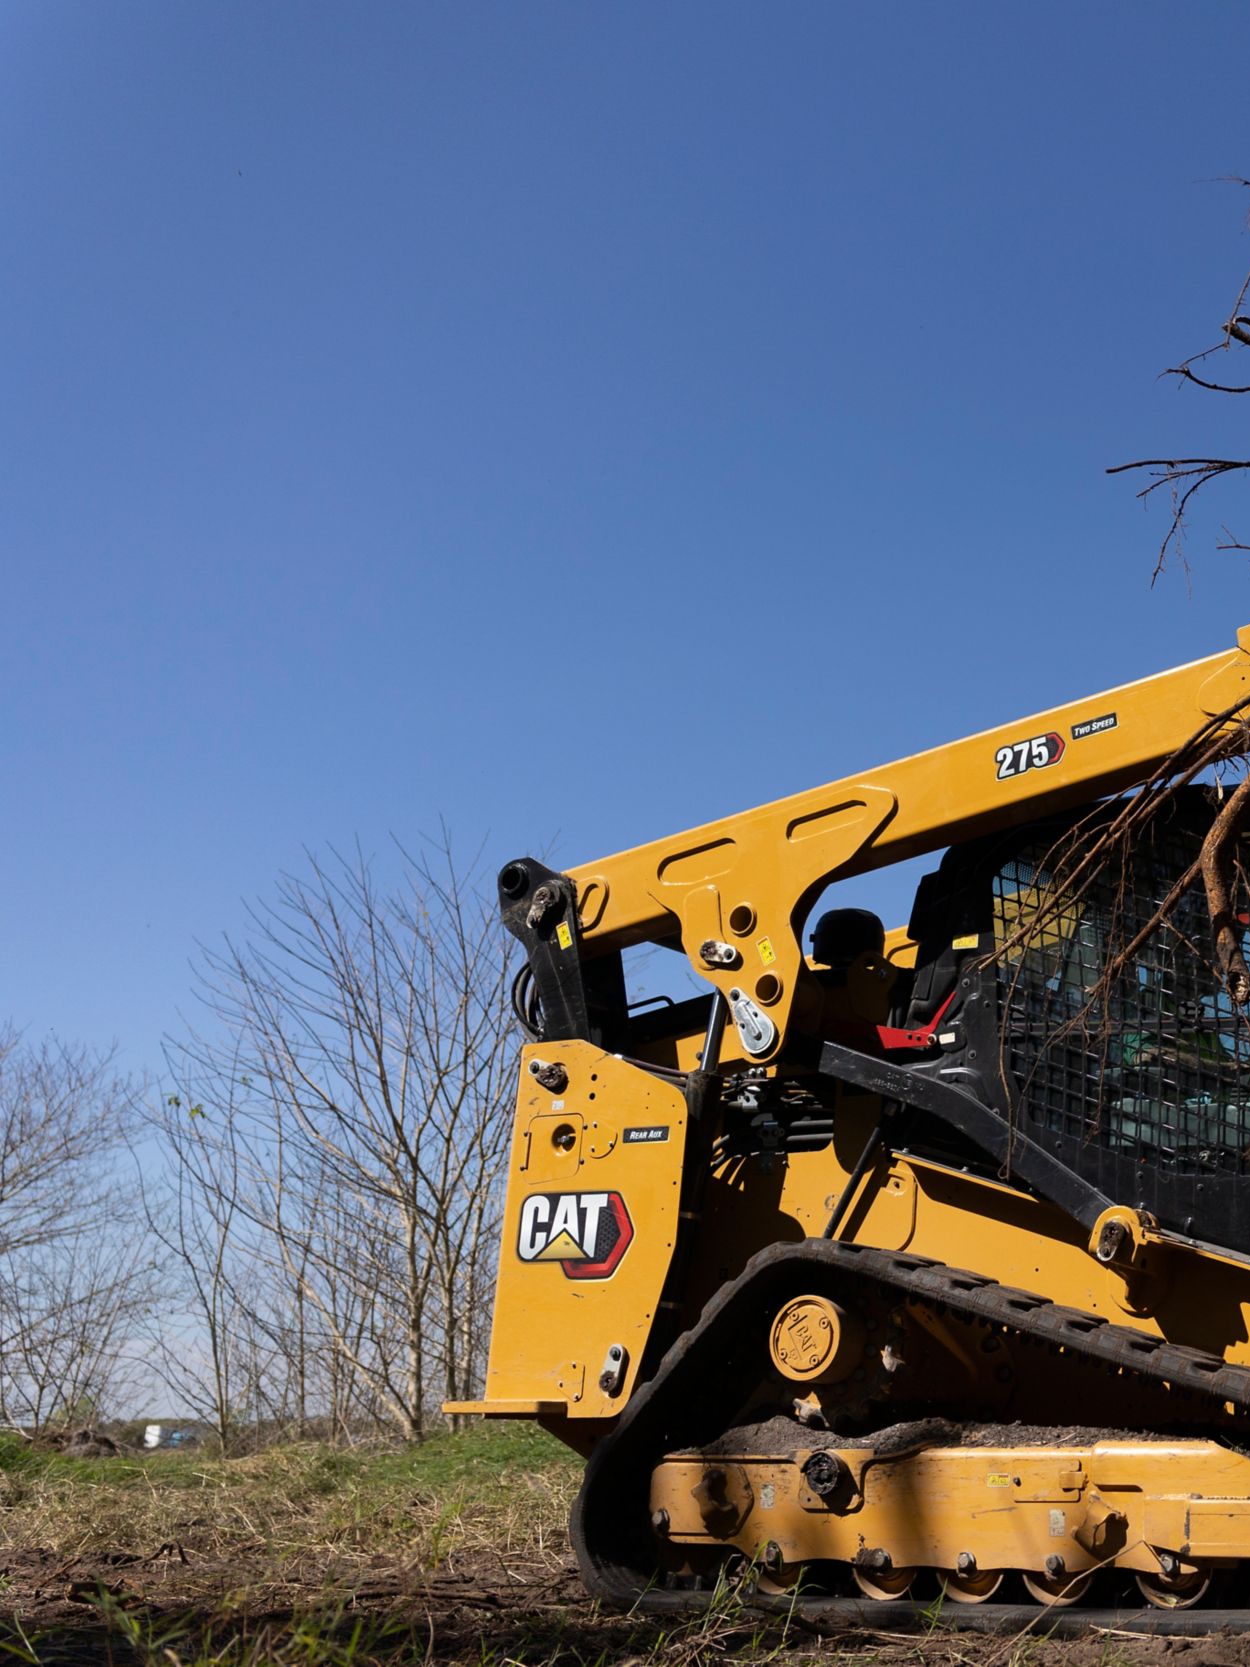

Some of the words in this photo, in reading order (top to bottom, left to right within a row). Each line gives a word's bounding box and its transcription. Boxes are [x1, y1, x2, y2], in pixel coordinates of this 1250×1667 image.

[996, 737, 1049, 778] 275
[518, 1193, 609, 1260] CAT
[796, 1326, 817, 1352] CAT
